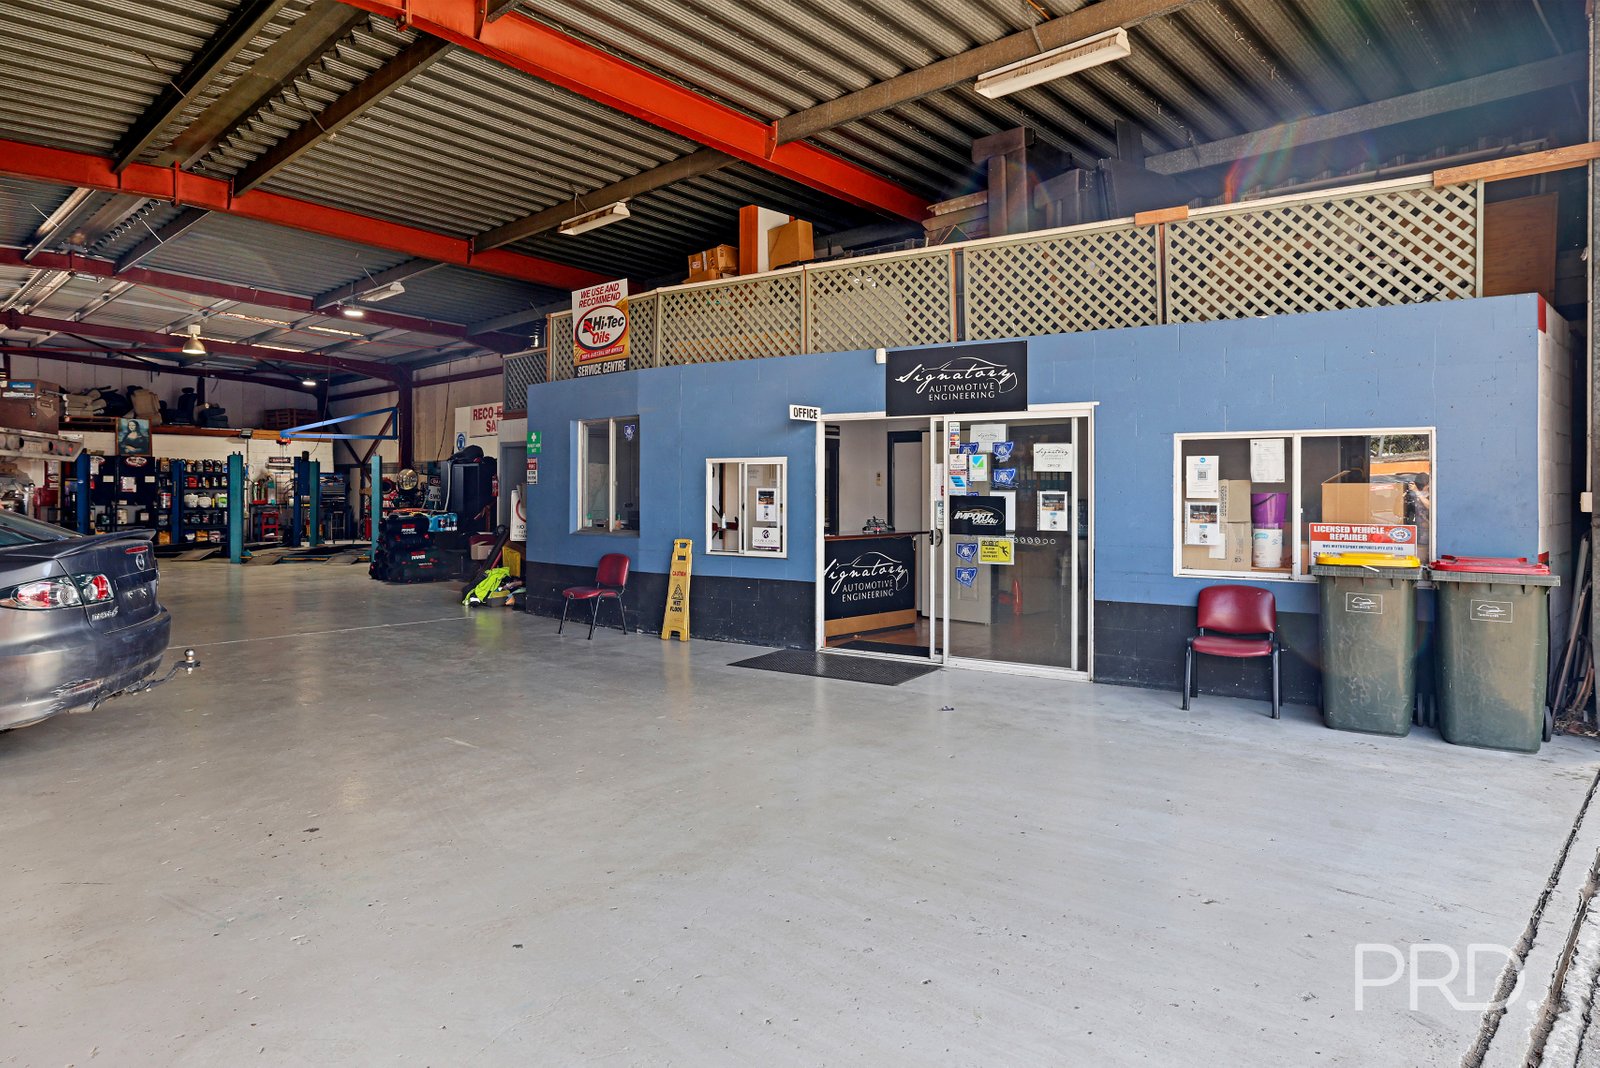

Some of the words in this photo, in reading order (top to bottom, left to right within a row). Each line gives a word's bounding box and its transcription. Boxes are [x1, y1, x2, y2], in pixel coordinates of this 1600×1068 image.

[580, 289, 591, 300] WE
[592, 286, 604, 297] USE
[604, 282, 620, 294] AND
[579, 291, 621, 309] RECOMMEND
[592, 331, 610, 345] Oils
[577, 363, 602, 377] SERVICE
[602, 360, 626, 374] CENTRE
[895, 363, 1018, 395] Signatory
[929, 382, 995, 393] AUTOMOTIVE
[928, 390, 995, 402] ENGINEERING
[793, 407, 818, 420] OFFICE
[1313, 525, 1350, 534] LICENSED
[1351, 526, 1385, 535] VEHICLE
[1329, 533, 1368, 542] REPAIRER
[842, 579, 893, 593] AUTOMOTIVE
[842, 589, 894, 603] ENGINEERING
